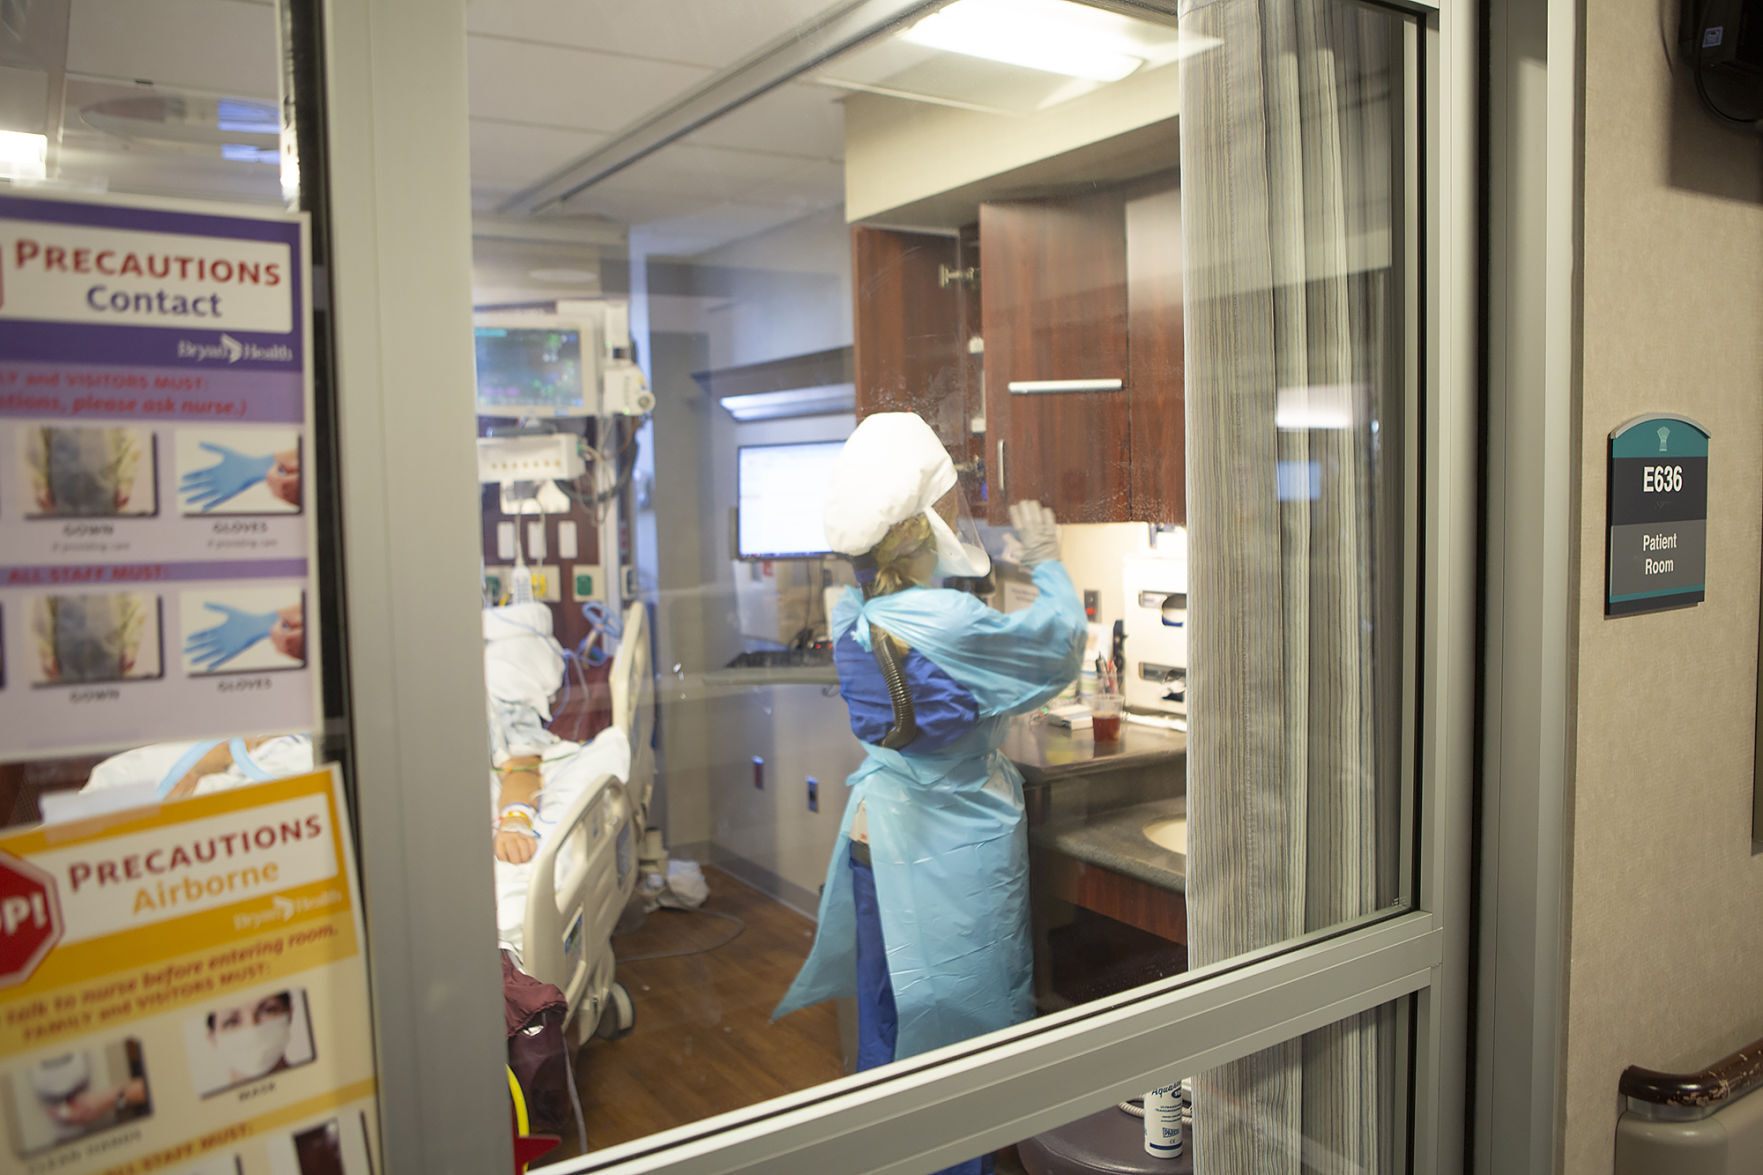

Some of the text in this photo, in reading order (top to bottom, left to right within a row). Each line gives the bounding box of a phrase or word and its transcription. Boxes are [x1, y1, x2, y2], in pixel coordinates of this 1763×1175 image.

[15, 238, 282, 287] PRECAUTIONS
[86, 285, 223, 318] Contact
[1643, 465, 1683, 493] E636
[1643, 533, 1677, 551] Patient
[1645, 558, 1674, 575] Room
[68, 814, 322, 893] PRECAUTIONS
[132, 861, 279, 916] Airborne
